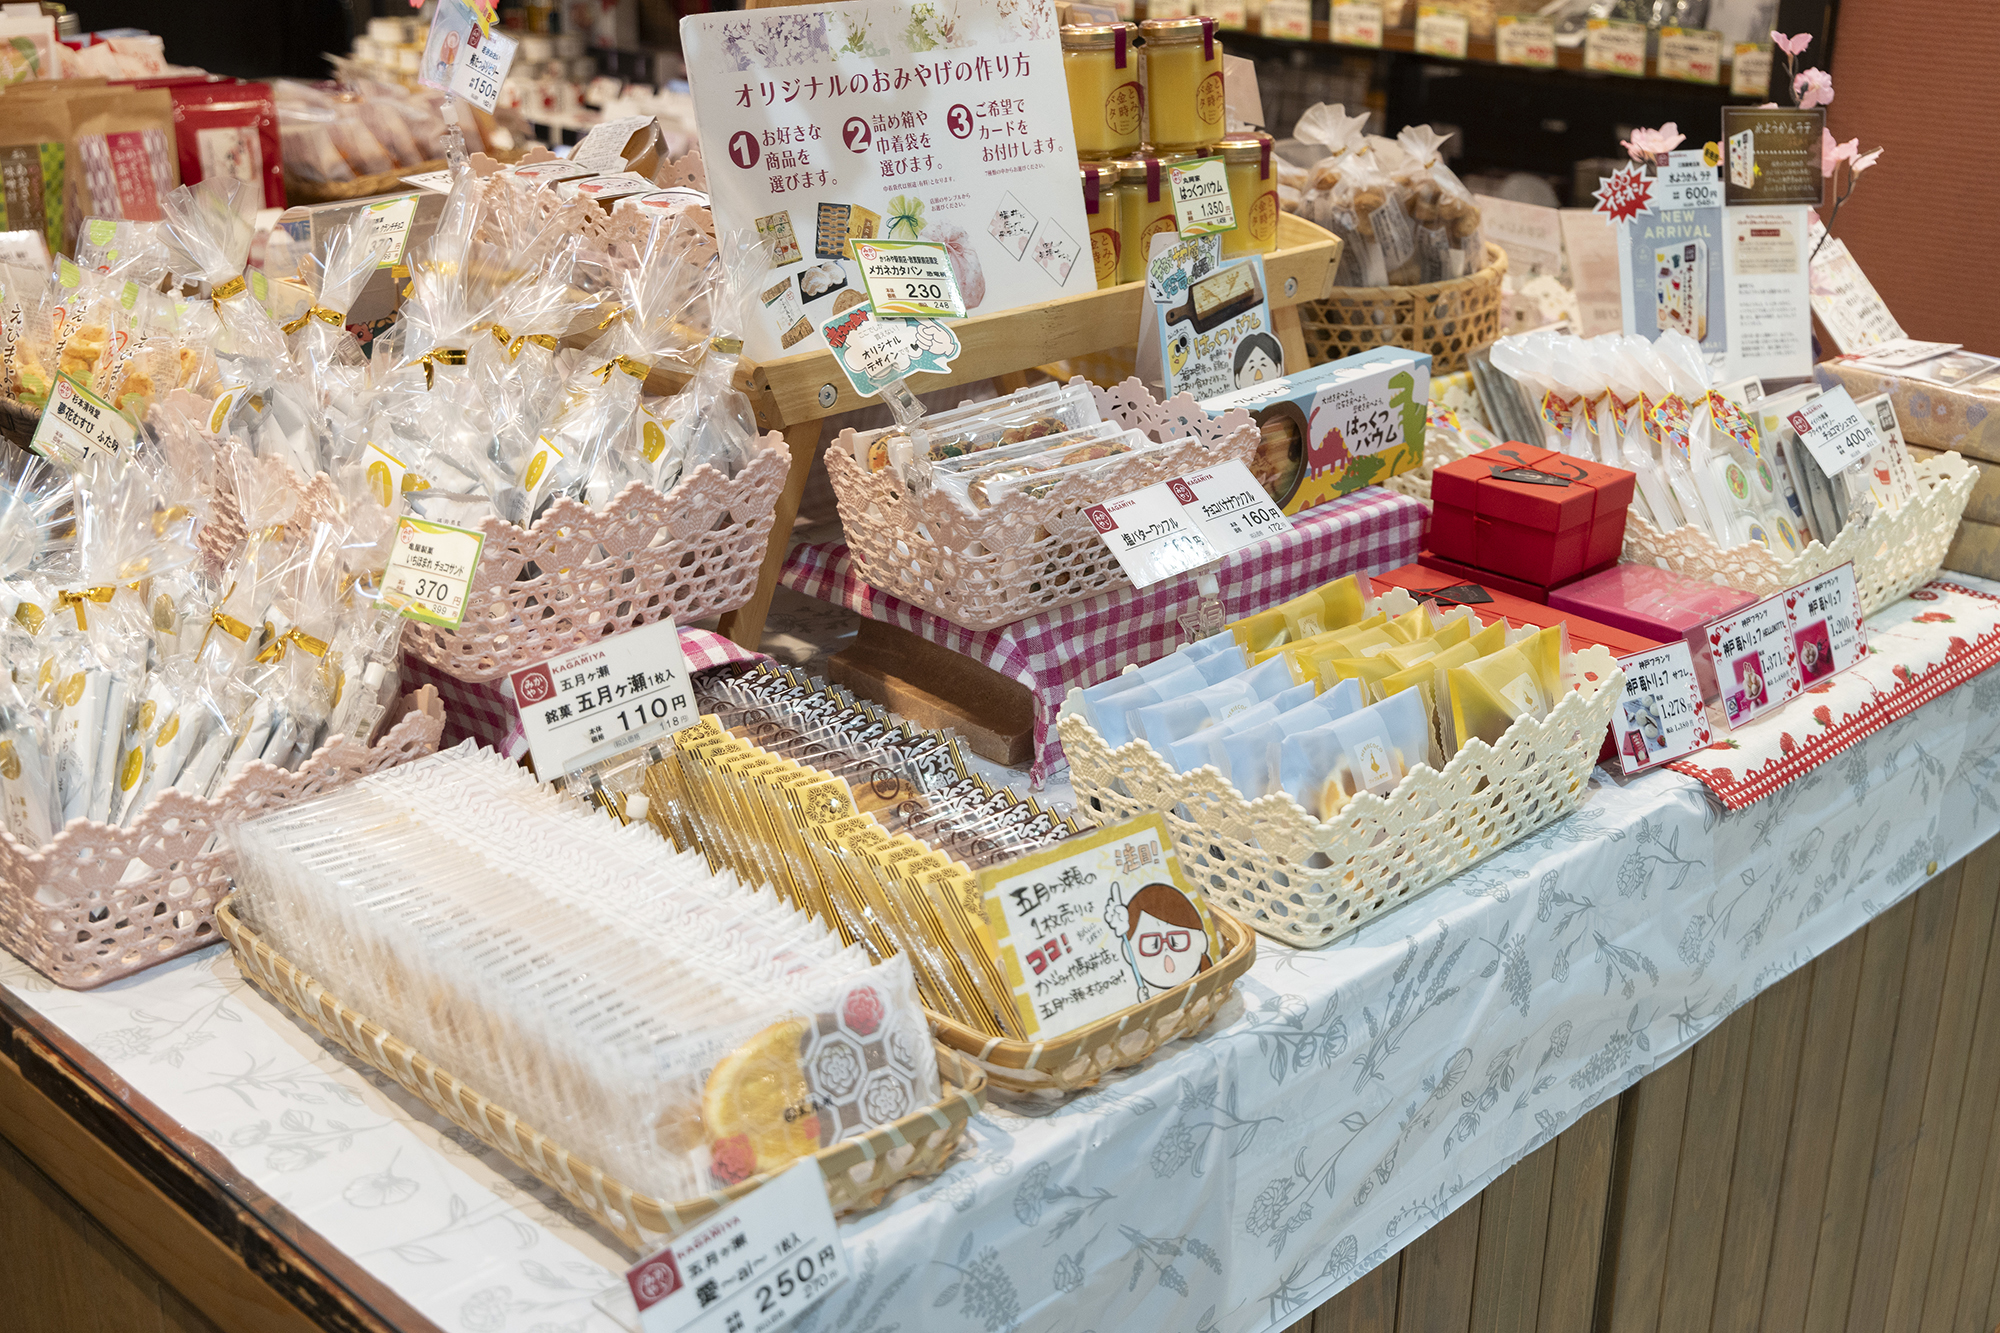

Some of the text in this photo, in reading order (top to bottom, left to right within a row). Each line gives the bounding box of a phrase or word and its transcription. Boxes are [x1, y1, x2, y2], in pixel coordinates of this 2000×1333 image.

[473, 77, 493, 97] 150
[735, 52, 1030, 108] オリジナルのおみやげの作り方
[976, 98, 1025, 118] ご希望で
[1116, 91, 1130, 117] 金時
[872, 110, 928, 133] 詰め箱や
[979, 119, 1029, 140] カードを
[1754, 120, 1812, 135] 水ようかんラテ
[762, 123, 821, 147] お好きな
[876, 132, 932, 155] 巾着袋を
[765, 149, 810, 170] 商品を
[982, 137, 1063, 163] お付けします。
[880, 154, 942, 177] 選びます。
[769, 169, 838, 194] 選びます。
[1669, 171, 1712, 183] 水ようかん ラテ
[1179, 180, 1224, 200] はっくつバウム
[1685, 186, 1709, 199] 600
[1201, 200, 1224, 216] 1,350
[1661, 210, 1696, 223] NEW
[1644, 225, 1712, 239] ARRIVAL
[905, 283, 942, 299] 230
[933, 301, 950, 309] 248
[862, 336, 902, 360] オリジナル
[56, 401, 96, 434] 夢花むすび
[1346, 410, 1389, 437] はっくつ
[1822, 414, 1858, 441] チョコマシュマロ
[1356, 424, 1398, 451] バウム
[1846, 427, 1873, 448] 400 円
[1186, 473, 1215, 487] KAGAMIYA
[1106, 499, 1137, 513] KAGAMIYA
[1242, 507, 1281, 528] 160 円
[1268, 522, 1283, 534] 172
[1120, 517, 1180, 547] 塩バターワッフル
[408, 542, 435, 555] 亀屋製菓
[406, 554, 465, 577] いちほまれ チョコサンド
[415, 578, 462, 606] 370 円
[1814, 576, 1839, 594] 神戸フランツ
[431, 603, 447, 615] 399
[1808, 589, 1842, 617] 神戸苺トリュフ
[1741, 609, 1768, 628] 神戸フランツ
[1830, 615, 1851, 637] 1,200
[1722, 628, 1762, 659] 神戸苺トリュフ
[551, 651, 606, 675] KAGAMIYA
[1638, 653, 1671, 670] 神戸フランツ
[1761, 651, 1783, 674] 1,371
[1625, 668, 1690, 697] 神戸苺トリュフ サブレ
[544, 703, 574, 725] 銘菓
[648, 668, 676, 687] 1枚入
[617, 694, 687, 731] 110 円
[1661, 697, 1688, 720] 1,278
[589, 725, 603, 735] 本体
[659, 716, 680, 731] 118
[1674, 721, 1690, 732] 1,380
[591, 734, 605, 744] 価格
[1114, 840, 1160, 875] 注目!
[1030, 901, 1095, 940] 1枚売りは
[1026, 932, 1073, 976] ココ!
[755, 1244, 837, 1314] 250 円
